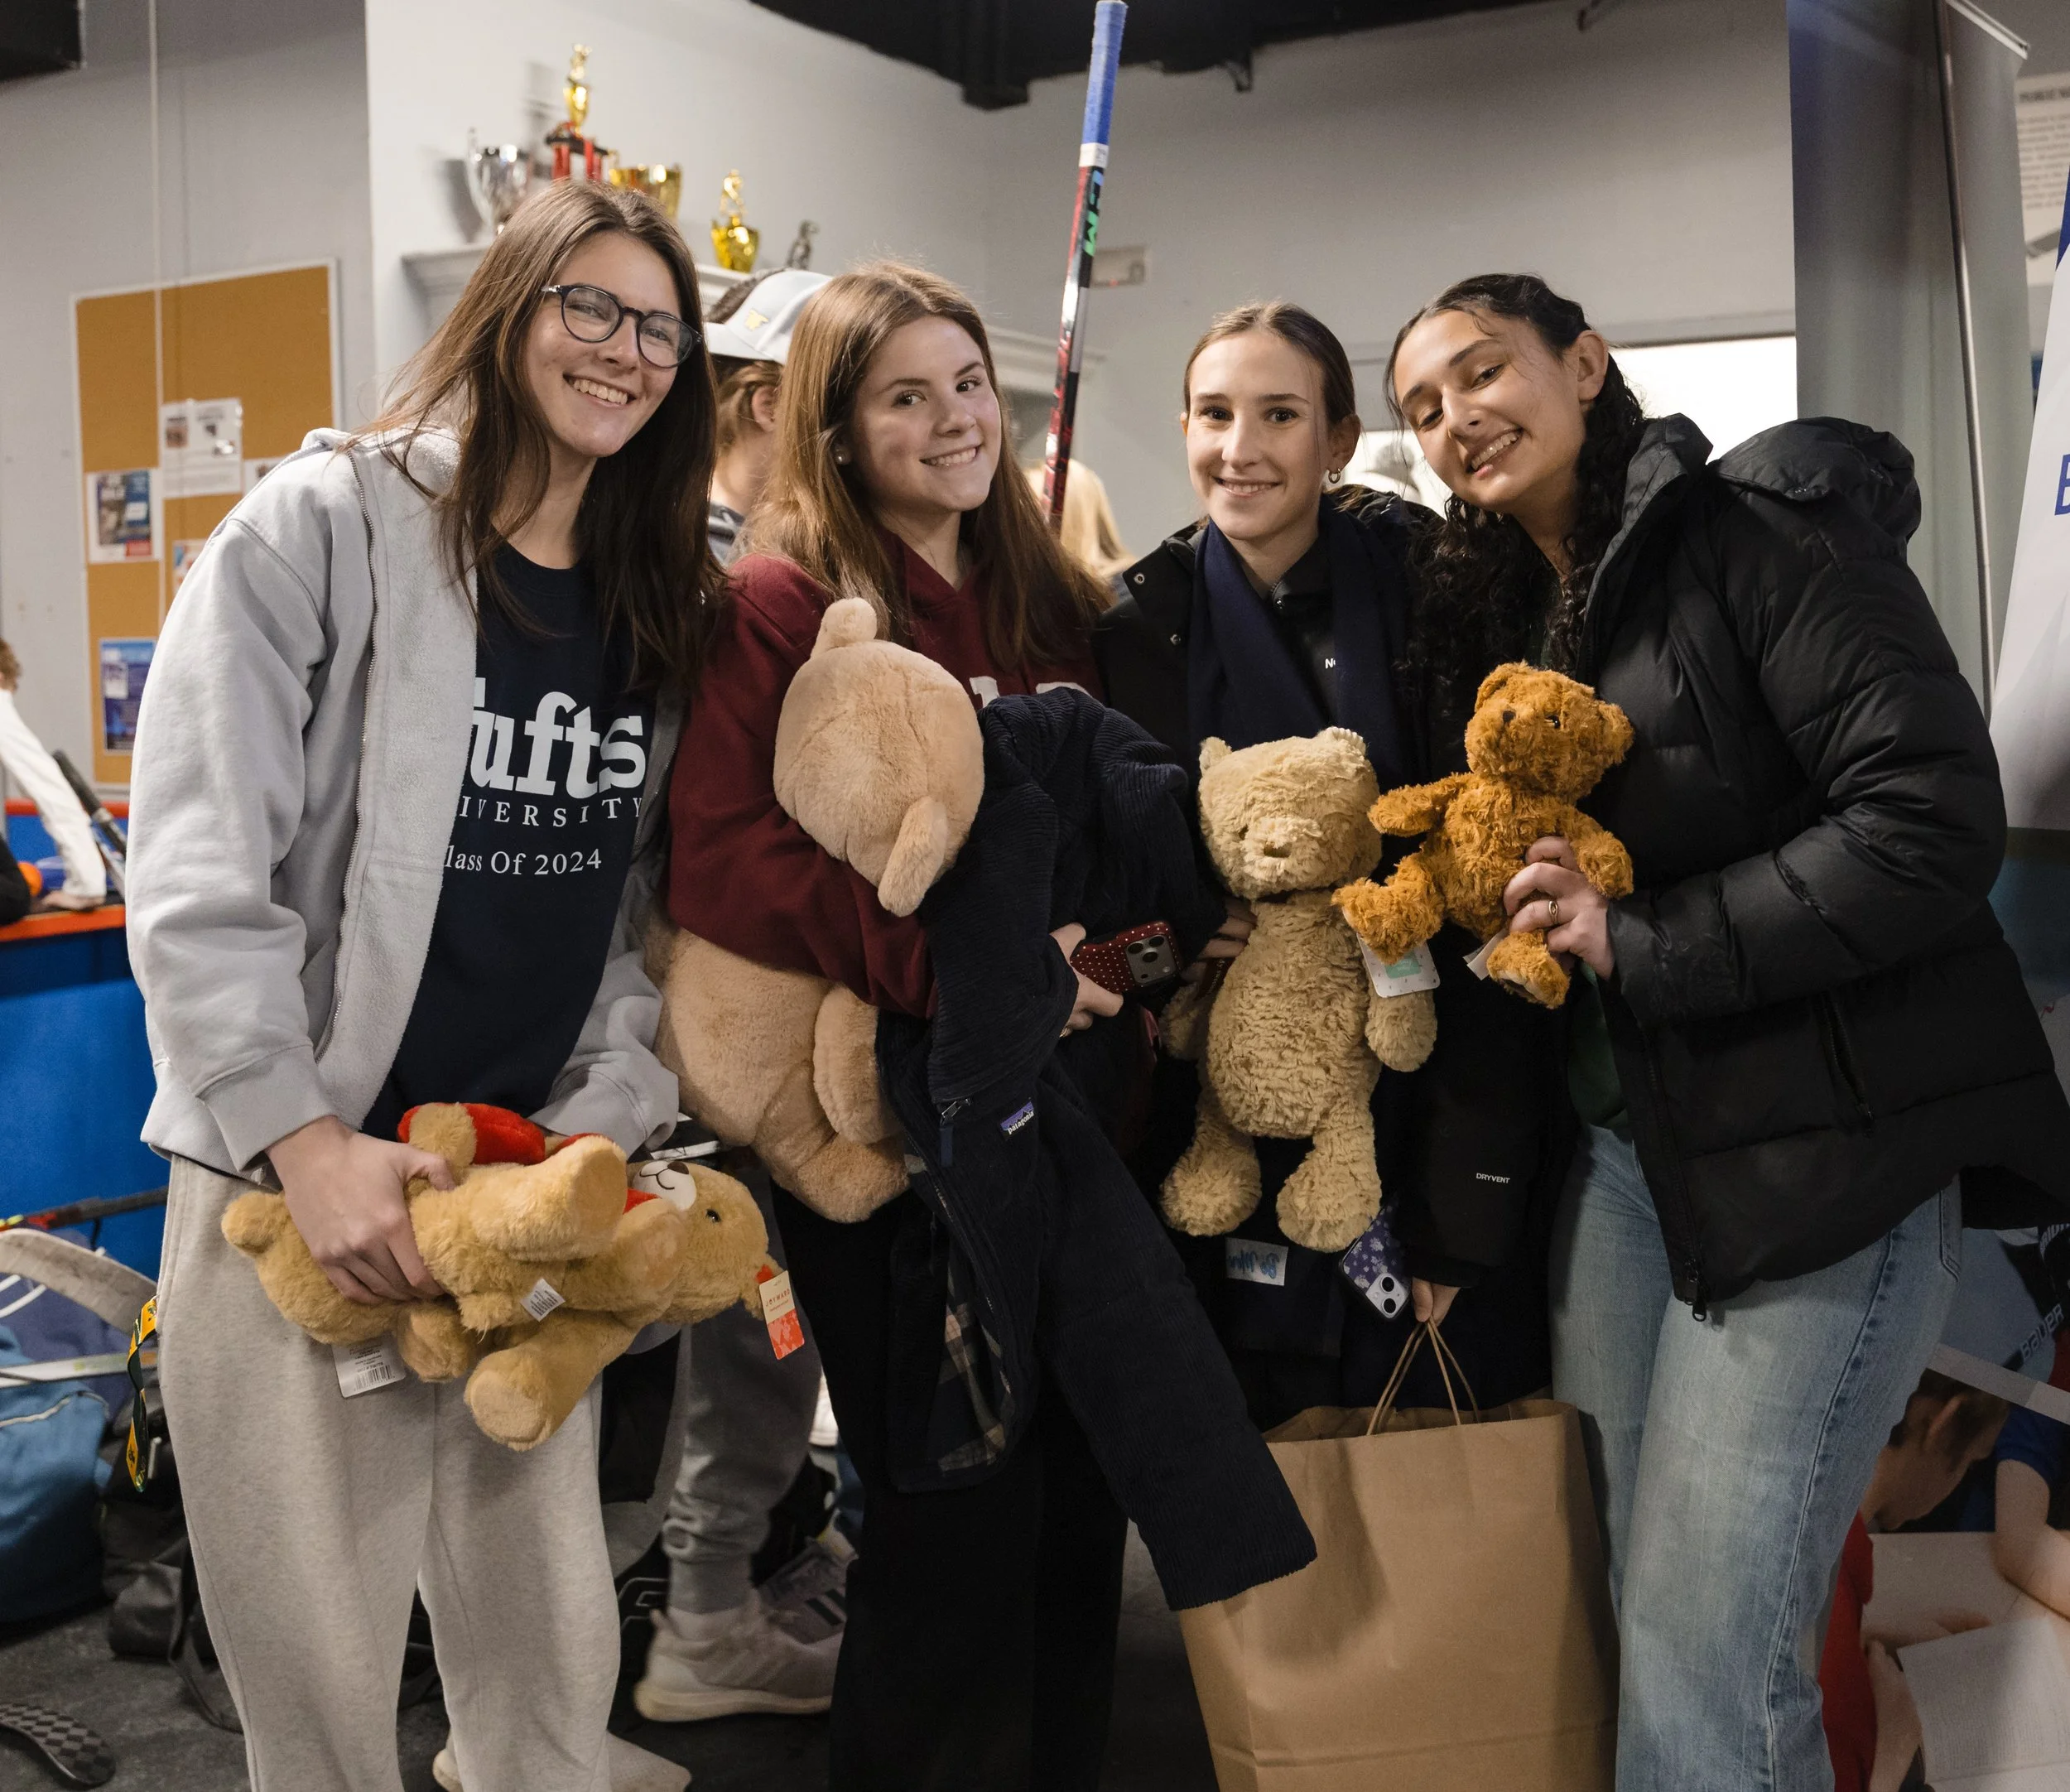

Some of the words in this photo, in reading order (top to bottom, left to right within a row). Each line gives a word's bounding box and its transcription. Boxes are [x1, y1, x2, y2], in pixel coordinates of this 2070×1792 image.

[460, 796, 643, 827] IVERSITY
[444, 845, 483, 871] lass
[490, 851, 527, 875] Of
[534, 848, 602, 875] 2024
[1008, 1110, 1034, 1135] patagonia
[1475, 1173, 1510, 1184] DRYVENT
